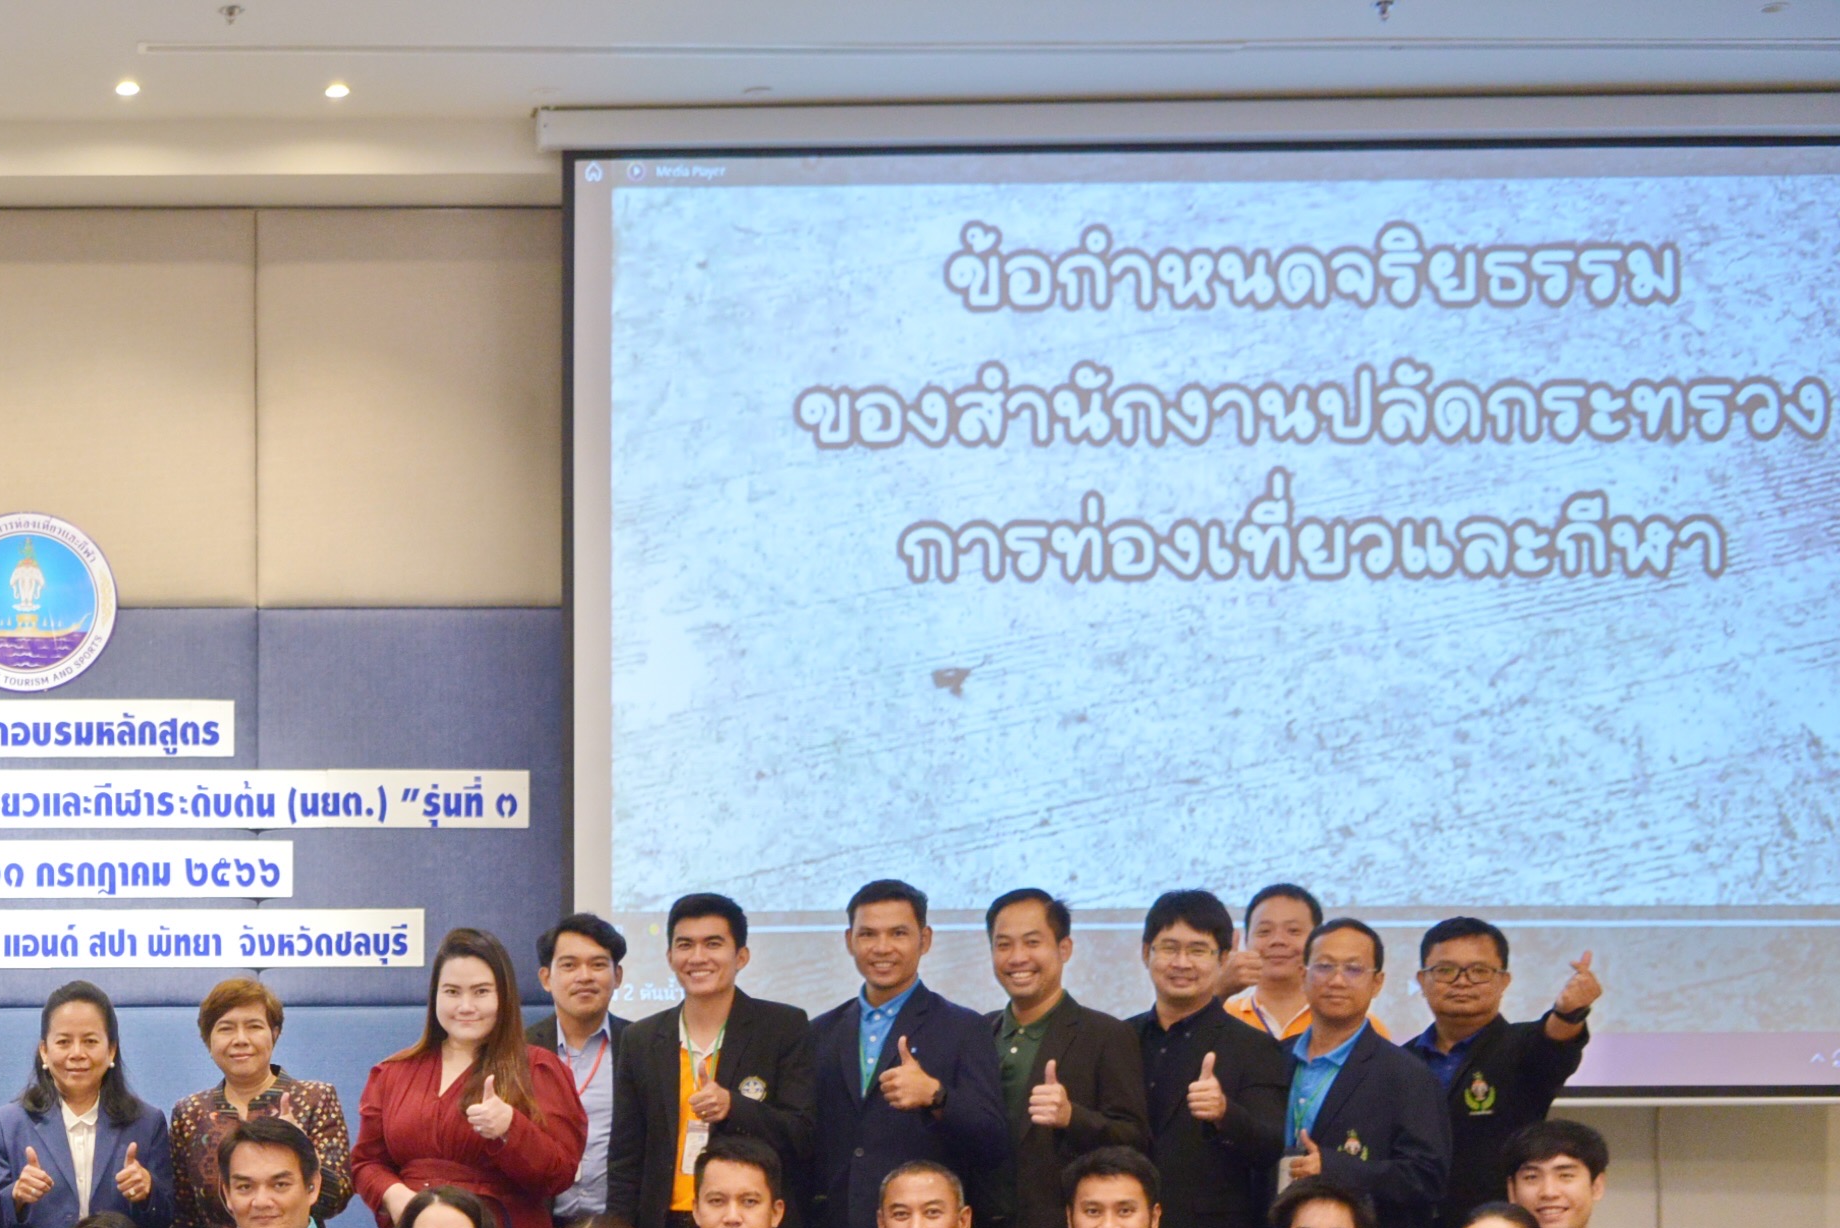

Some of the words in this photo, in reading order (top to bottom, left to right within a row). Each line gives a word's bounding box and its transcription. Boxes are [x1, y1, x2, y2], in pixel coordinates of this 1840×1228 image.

[655, 164, 690, 177] Media
[692, 165, 726, 181] Player
[946, 222, 1680, 312] ข้อกำหนดจริยธรรม
[796, 360, 1834, 447] ของสำนักงานปลัดกระทรวง
[899, 467, 1727, 582] การท่องเที่ยวและกีฬา
[4, 674, 50, 687] TOURISM
[53, 665, 74, 682] AND
[74, 634, 103, 670] SPORTS
[36, 860, 171, 895] กรกฎาคม
[185, 857, 280, 888] ๒๕๖๖
[4, 924, 78, 957] แอนด์
[89, 928, 137, 957] สปา
[148, 926, 222, 957] พัทยา
[240, 924, 408, 965] จังหวัดชลบุรี
